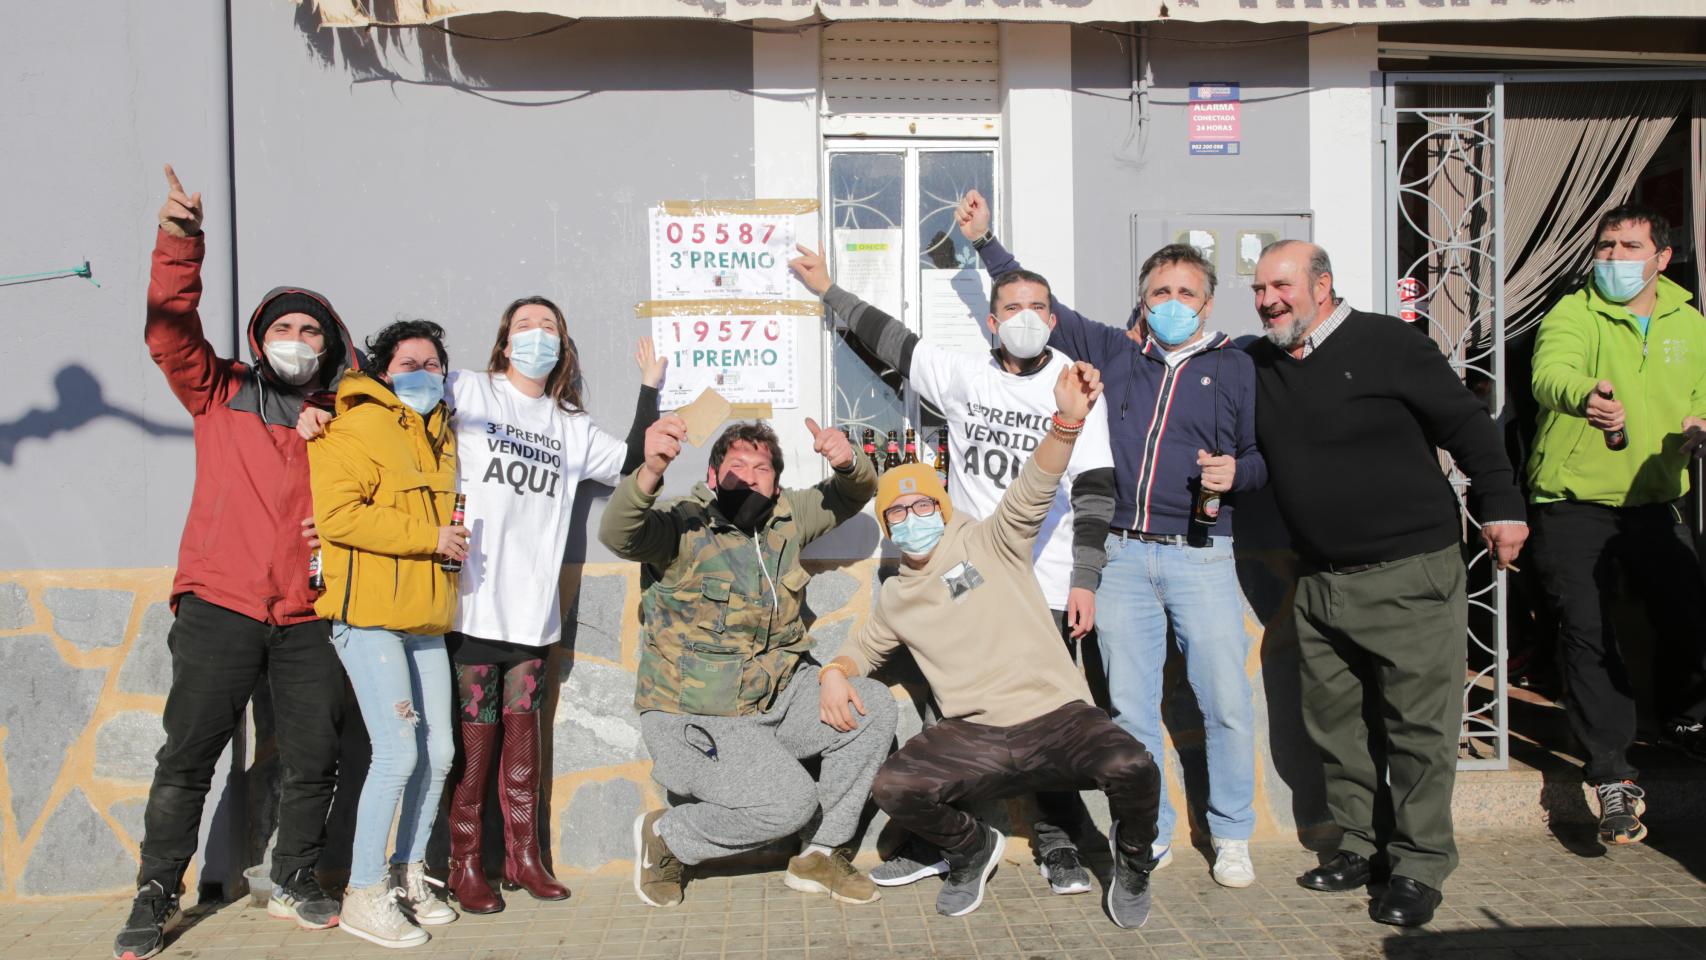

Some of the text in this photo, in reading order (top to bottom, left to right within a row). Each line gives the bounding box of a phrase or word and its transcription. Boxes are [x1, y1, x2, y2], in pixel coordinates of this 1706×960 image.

[666, 222, 776, 245] 05587
[506, 424, 561, 451] PREMIO
[965, 422, 1039, 452] VENDID
[487, 438, 561, 469] VENDIDO
